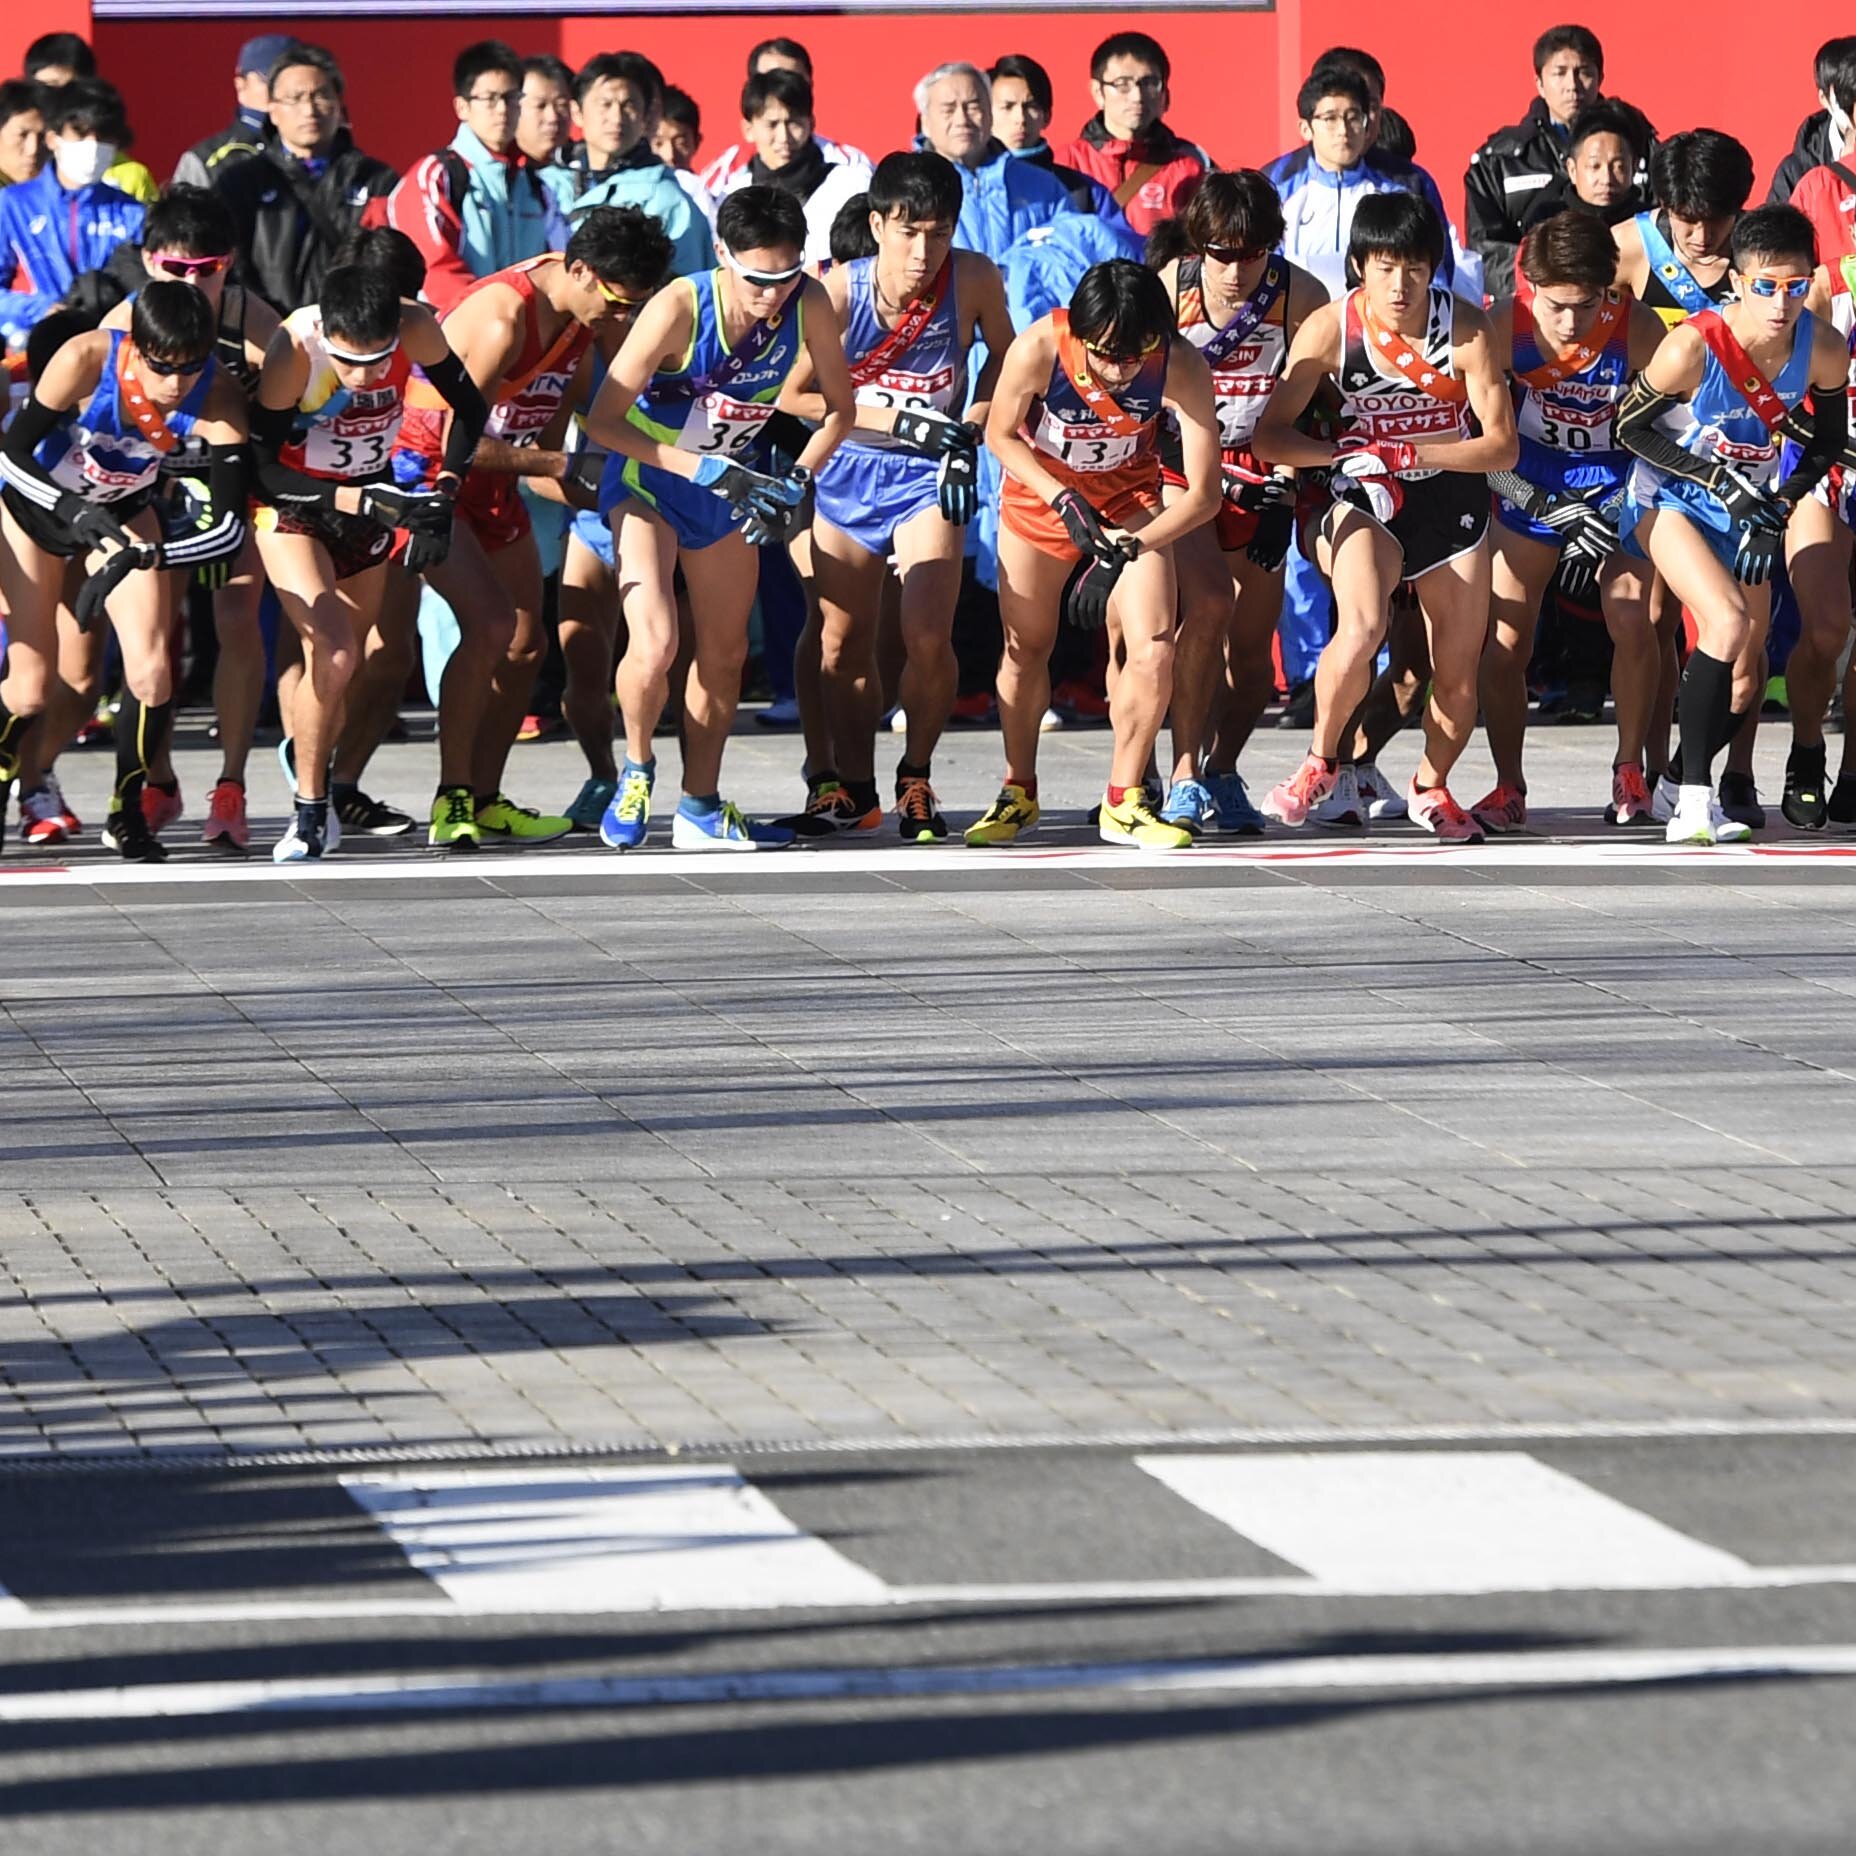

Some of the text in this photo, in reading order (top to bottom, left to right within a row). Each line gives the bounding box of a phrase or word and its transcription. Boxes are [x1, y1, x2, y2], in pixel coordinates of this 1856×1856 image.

[879, 371, 949, 391] ヤマザキ
[1213, 379, 1272, 394] マザキ
[1378, 411, 1453, 433] ヤマザキ
